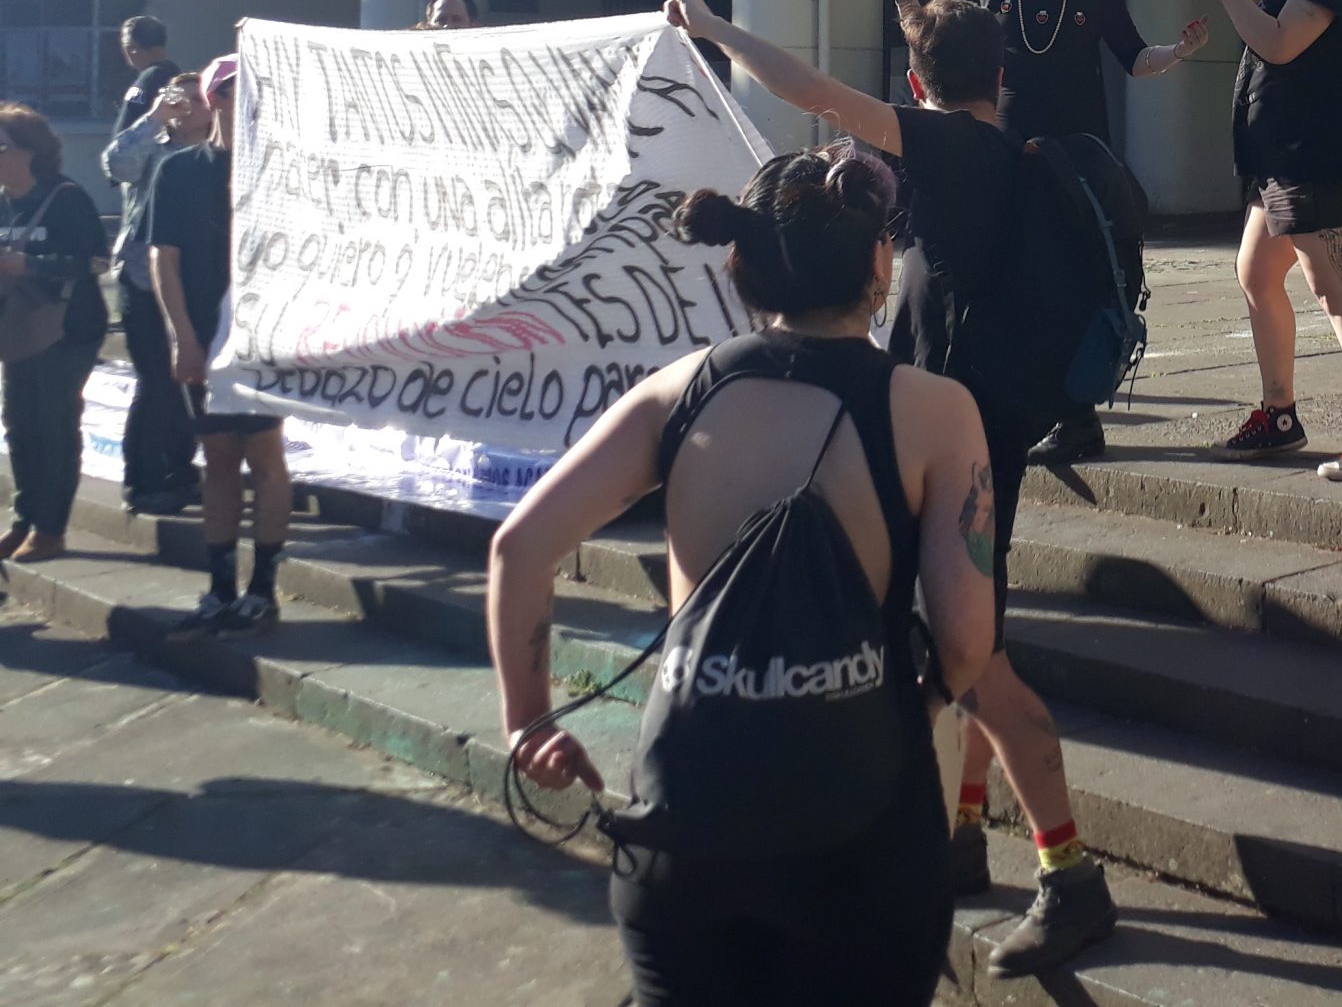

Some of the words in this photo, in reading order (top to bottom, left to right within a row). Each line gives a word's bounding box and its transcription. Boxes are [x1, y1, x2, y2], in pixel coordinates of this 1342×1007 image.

[398, 359, 456, 419] de
[460, 353, 565, 421] cielo
[564, 361, 661, 448] par
[697, 640, 884, 700] Skullcandy
